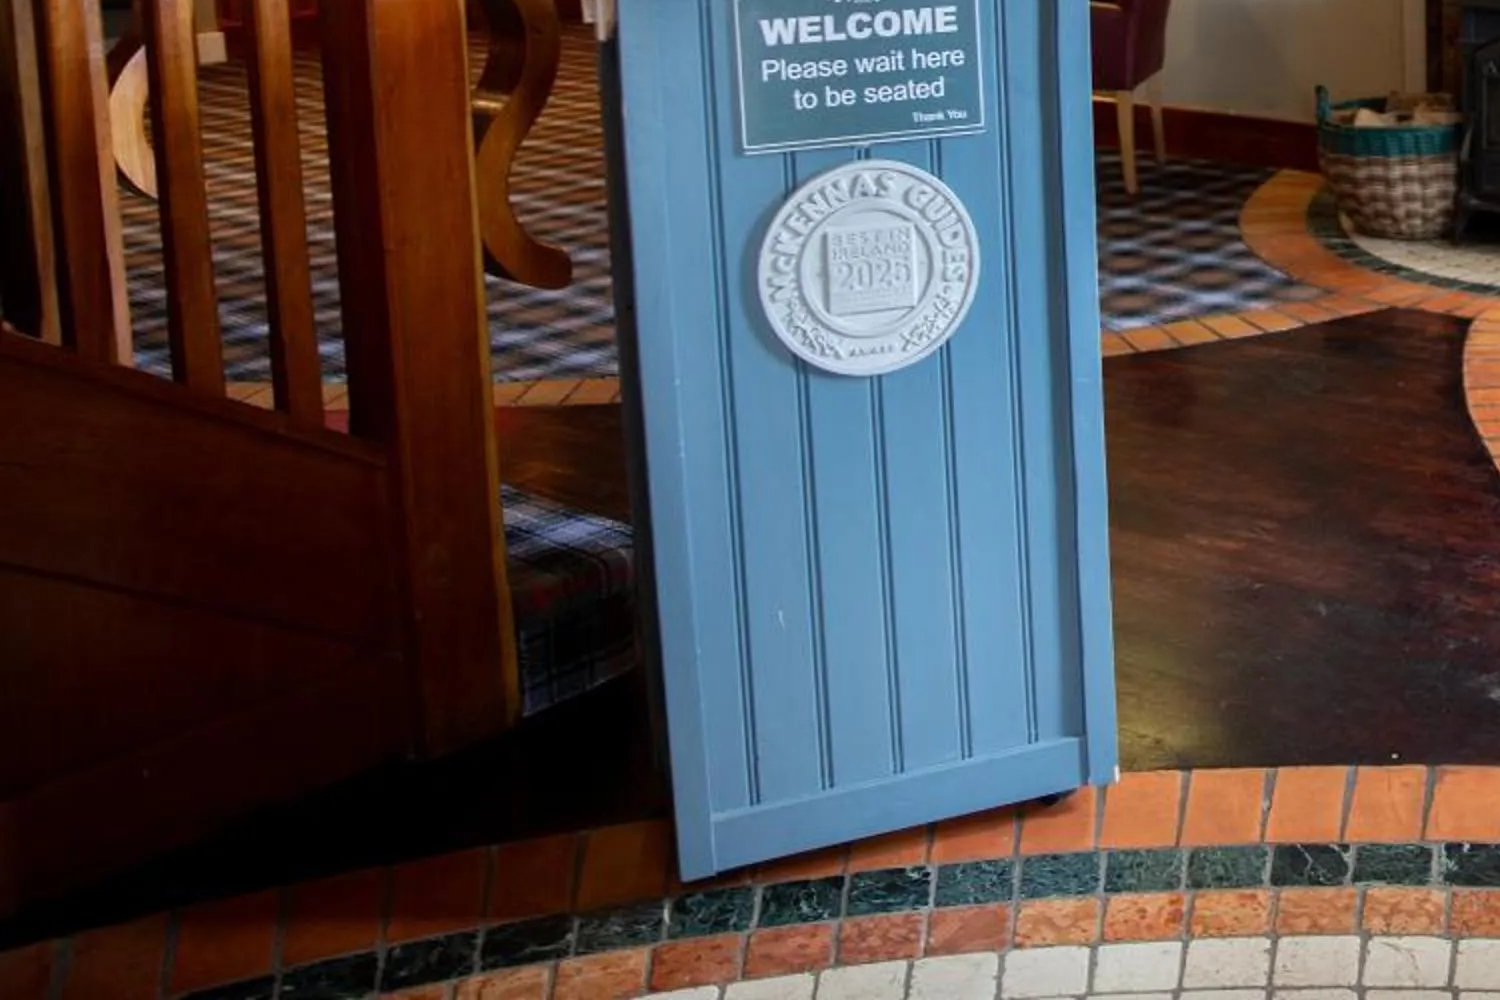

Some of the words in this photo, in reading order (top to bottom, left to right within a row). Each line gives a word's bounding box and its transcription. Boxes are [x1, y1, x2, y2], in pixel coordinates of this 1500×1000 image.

[758, 5, 959, 47] WELCOME
[761, 57, 849, 82] Please
[854, 50, 905, 75] wait
[911, 48, 965, 70] here
[793, 88, 818, 110] to
[825, 85, 856, 107] be
[863, 76, 945, 104] seated
[912, 111, 944, 123] Thank
[946, 109, 967, 119] You
[831, 230, 883, 247] BEST
[888, 226, 911, 241] IN
[832, 241, 910, 261] IRELAND
